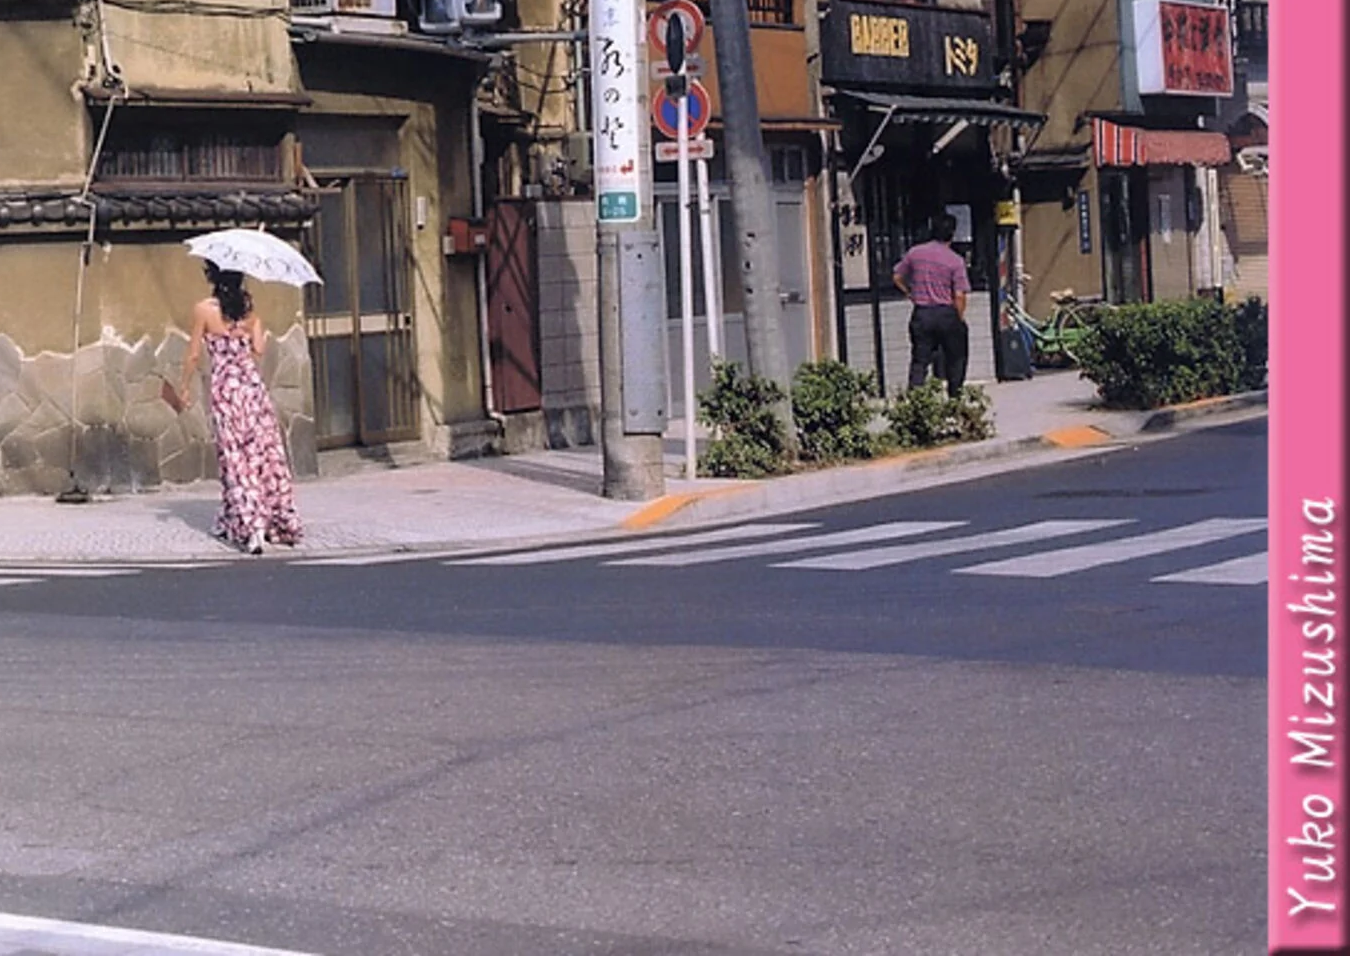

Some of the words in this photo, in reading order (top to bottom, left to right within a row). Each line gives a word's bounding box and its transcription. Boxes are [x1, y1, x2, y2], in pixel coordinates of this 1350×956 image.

[851, 14, 910, 57] BARBER
[945, 35, 979, 76] トミタ
